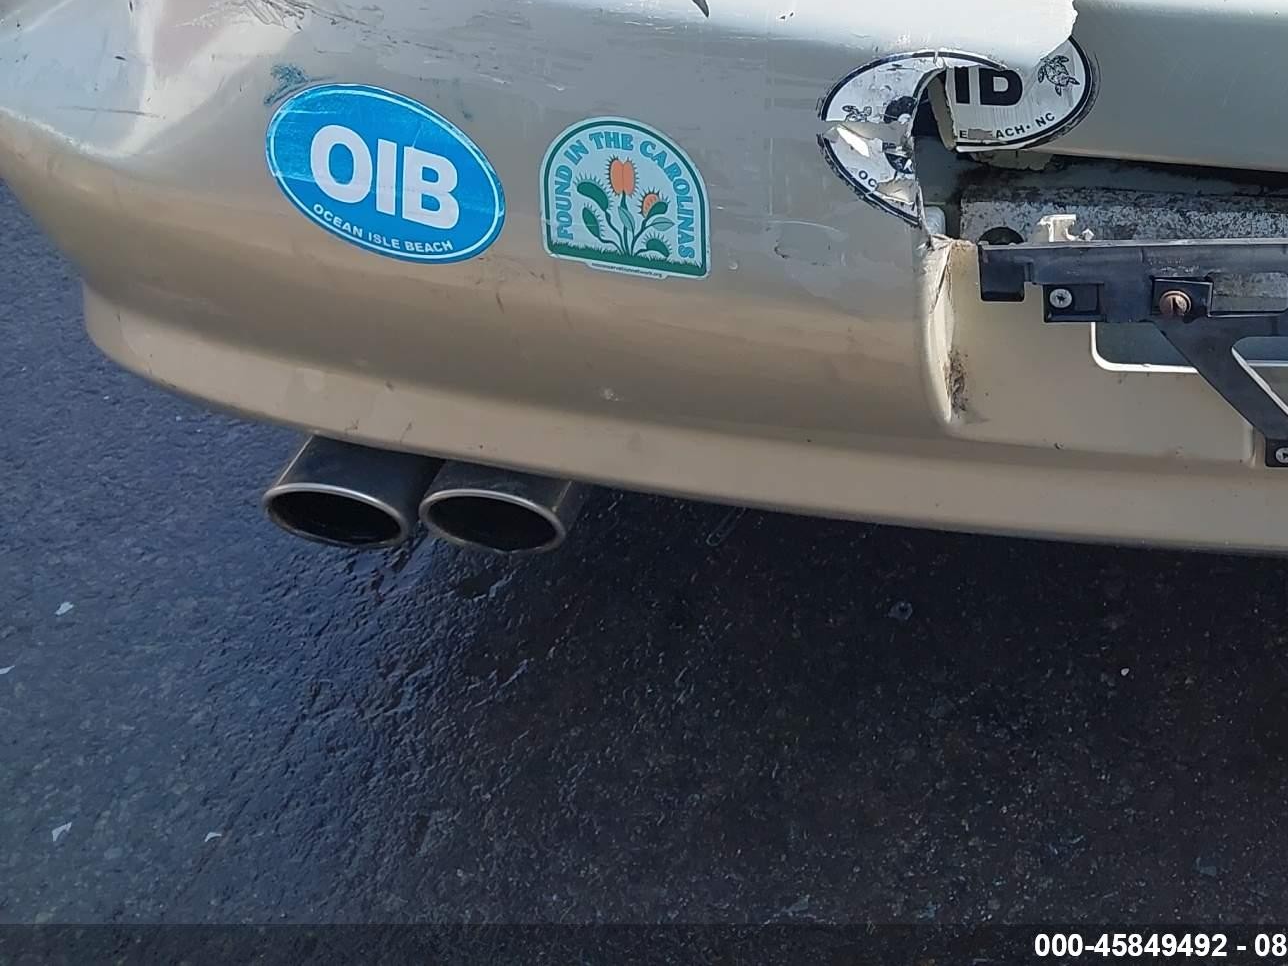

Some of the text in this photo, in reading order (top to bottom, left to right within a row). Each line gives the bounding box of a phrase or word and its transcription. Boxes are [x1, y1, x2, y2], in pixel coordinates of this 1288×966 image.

[1035, 112, 1055, 127] NC
[310, 125, 460, 230] OIB
[554, 131, 695, 259] FOUND IN THE CAROLINAS
[313, 203, 453, 253] OCEAN ISLE BEACH
